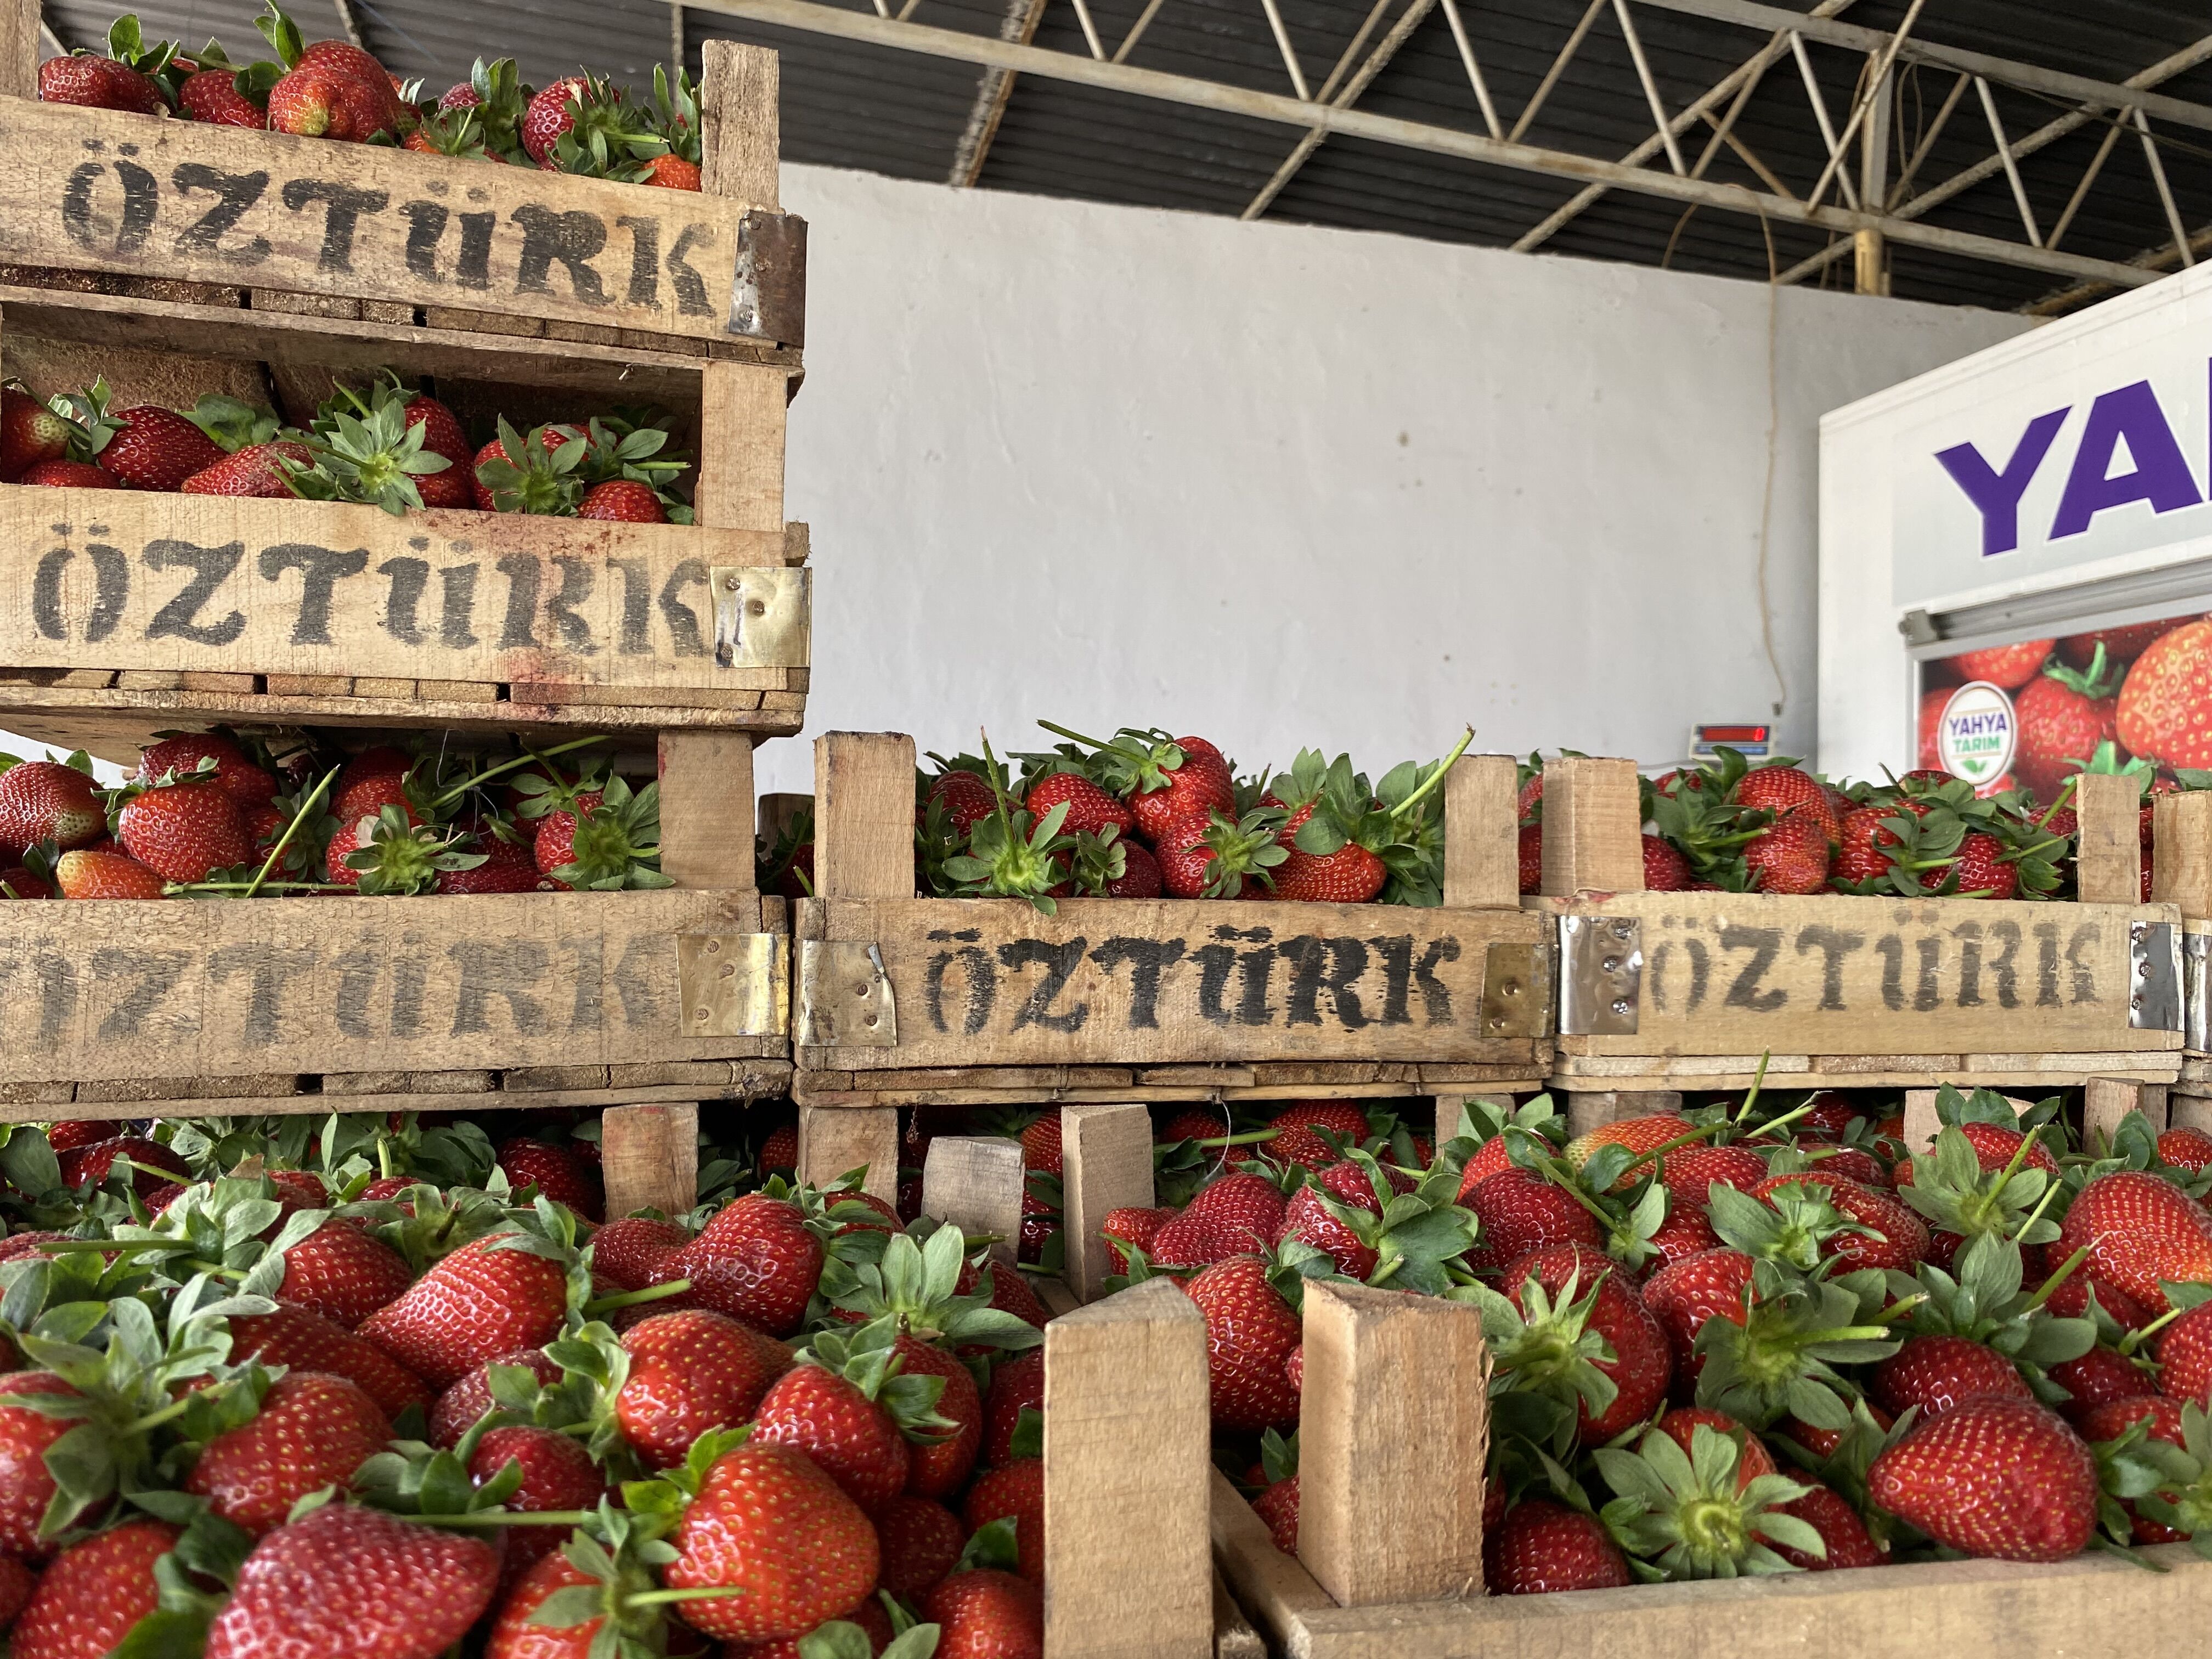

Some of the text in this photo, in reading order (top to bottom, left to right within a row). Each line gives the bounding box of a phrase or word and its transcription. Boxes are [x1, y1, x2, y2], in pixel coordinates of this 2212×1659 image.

[62, 138, 718, 317] ÖZTÜRK
[1933, 357, 2212, 557] YA
[32, 522, 709, 658] ÖZTÜRK
[1949, 713, 2007, 736] YAHYA
[1953, 736, 2000, 752] TARIM
[925, 924, 1462, 1035] ÖZTÜRK
[1650, 907, 2102, 1018] ÖZTÜRK
